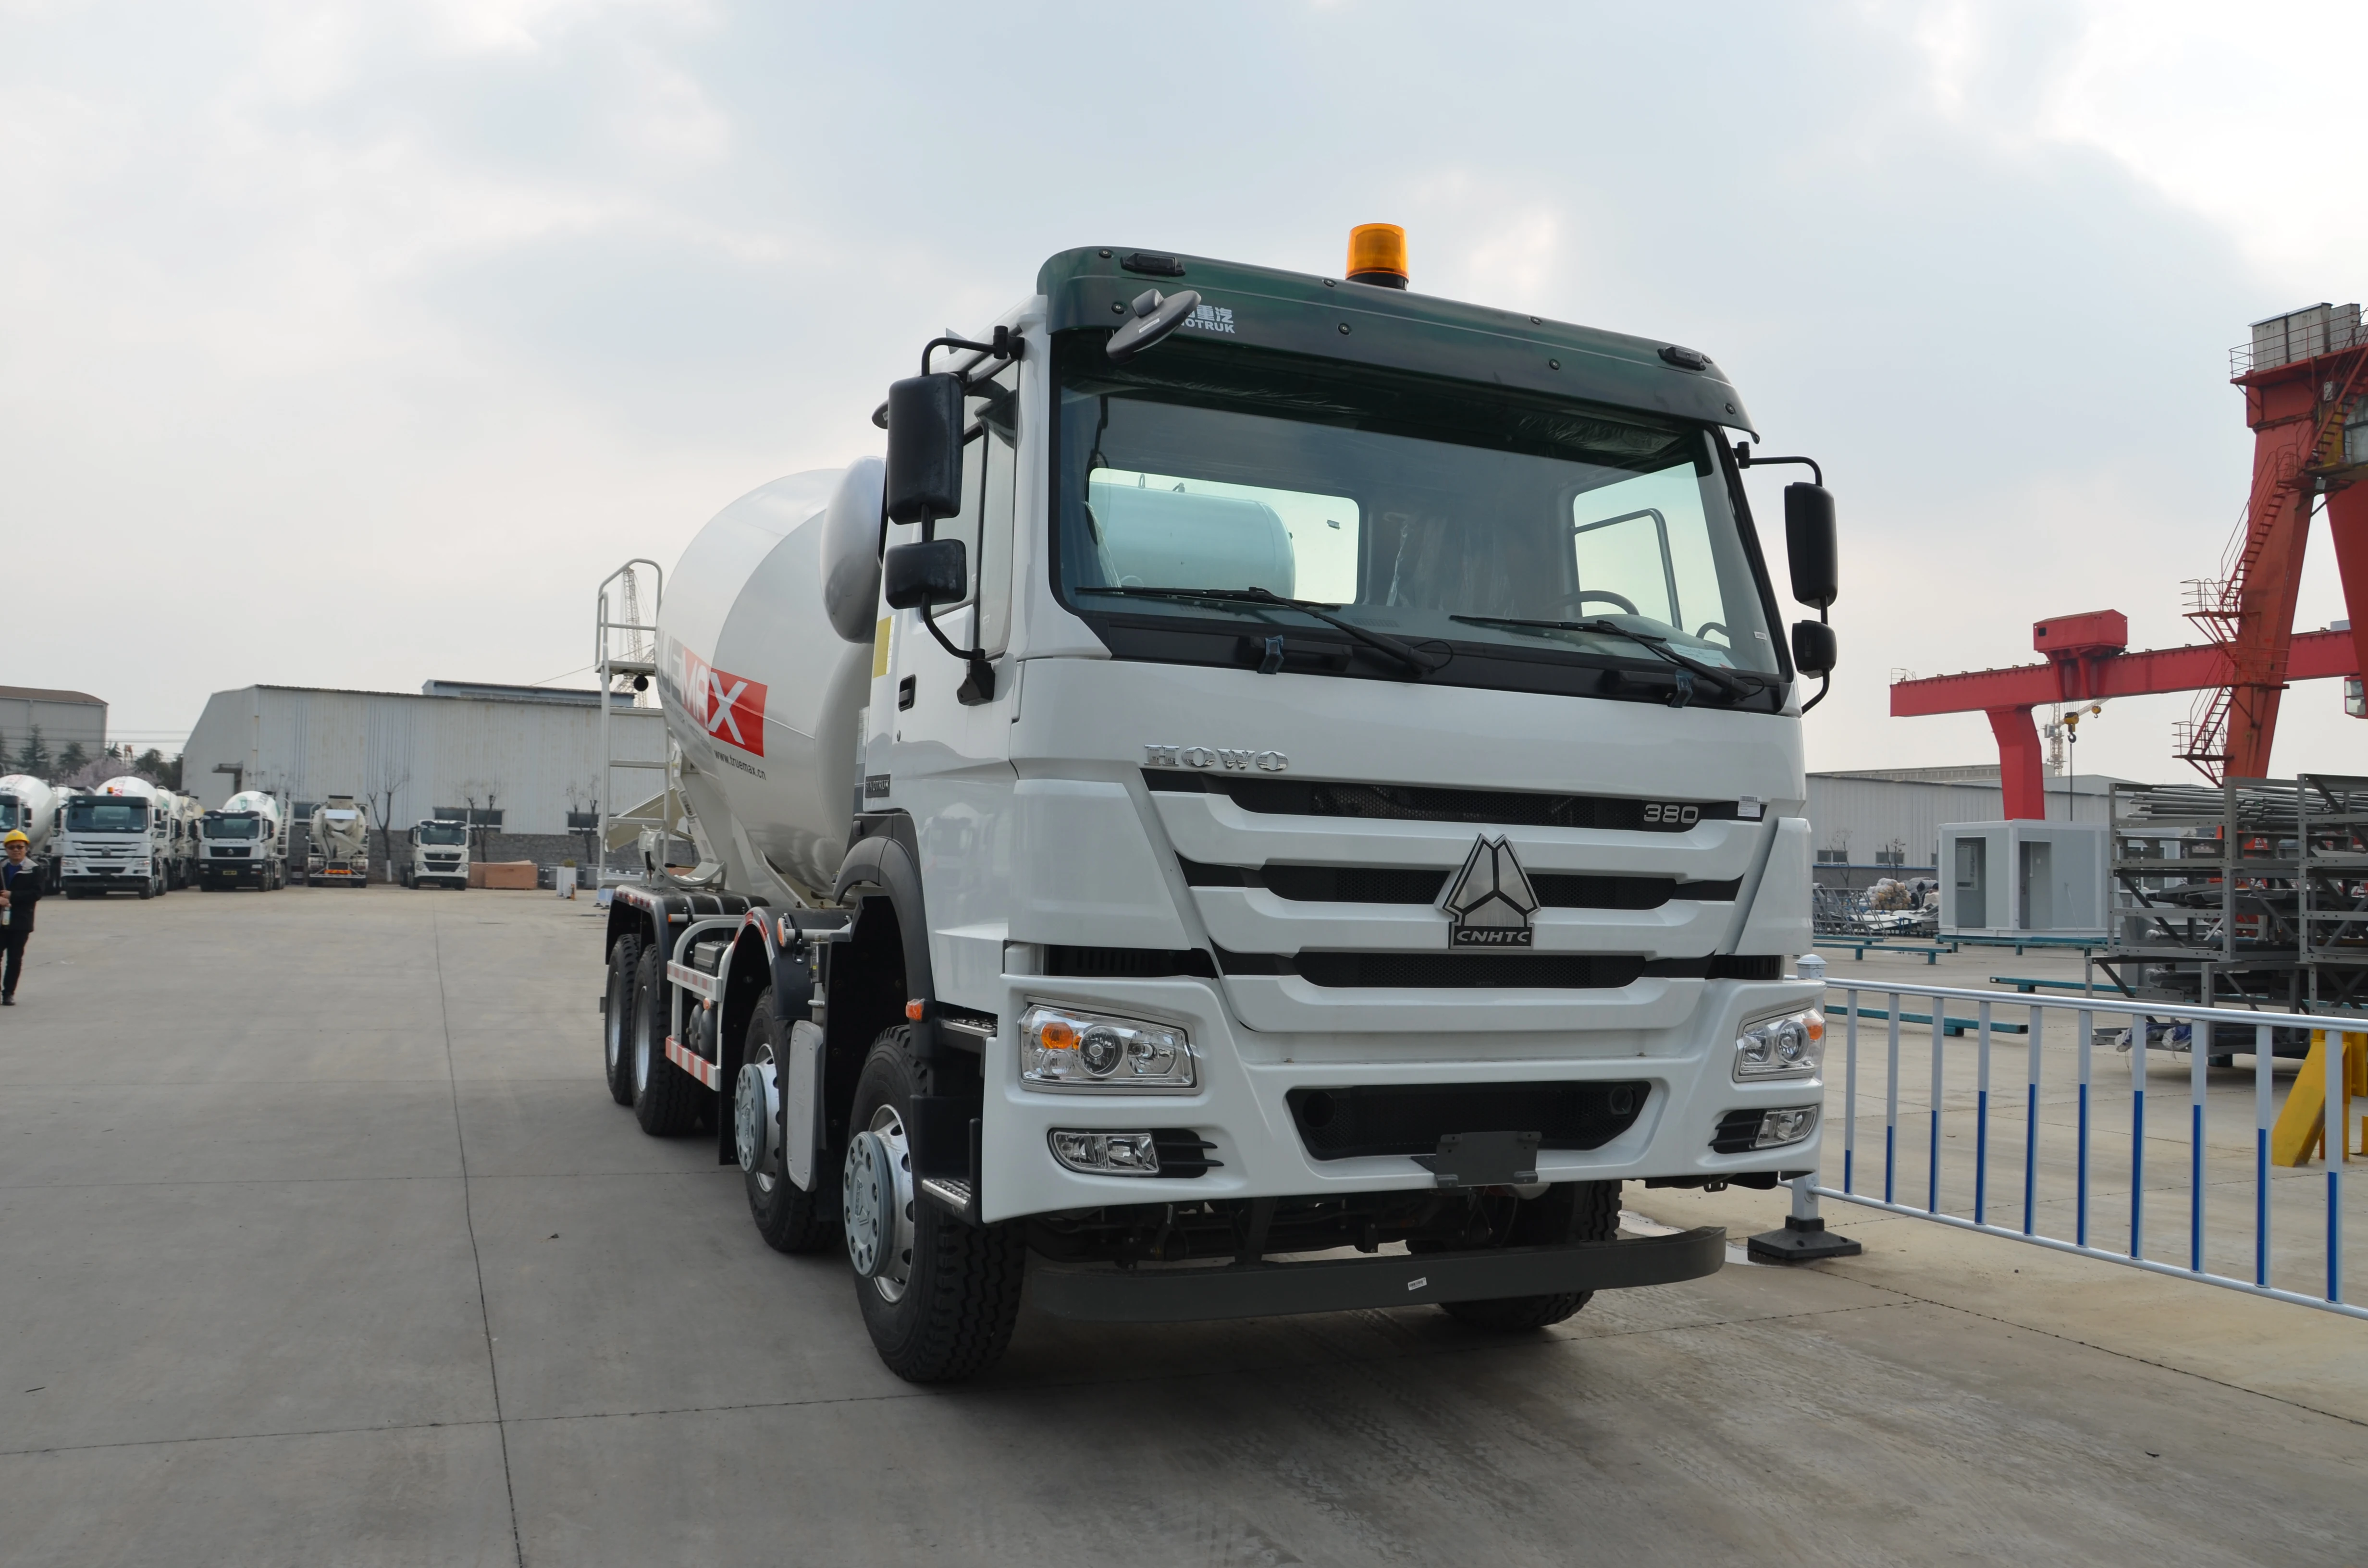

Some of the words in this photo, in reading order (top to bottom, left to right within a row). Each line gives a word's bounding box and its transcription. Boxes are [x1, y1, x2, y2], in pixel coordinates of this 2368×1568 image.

[714, 749, 766, 781] www.truemax.cn
[1144, 744, 1289, 772] HOWO
[1643, 804, 1699, 824] 380
[1457, 931, 1530, 943] CNHTC
